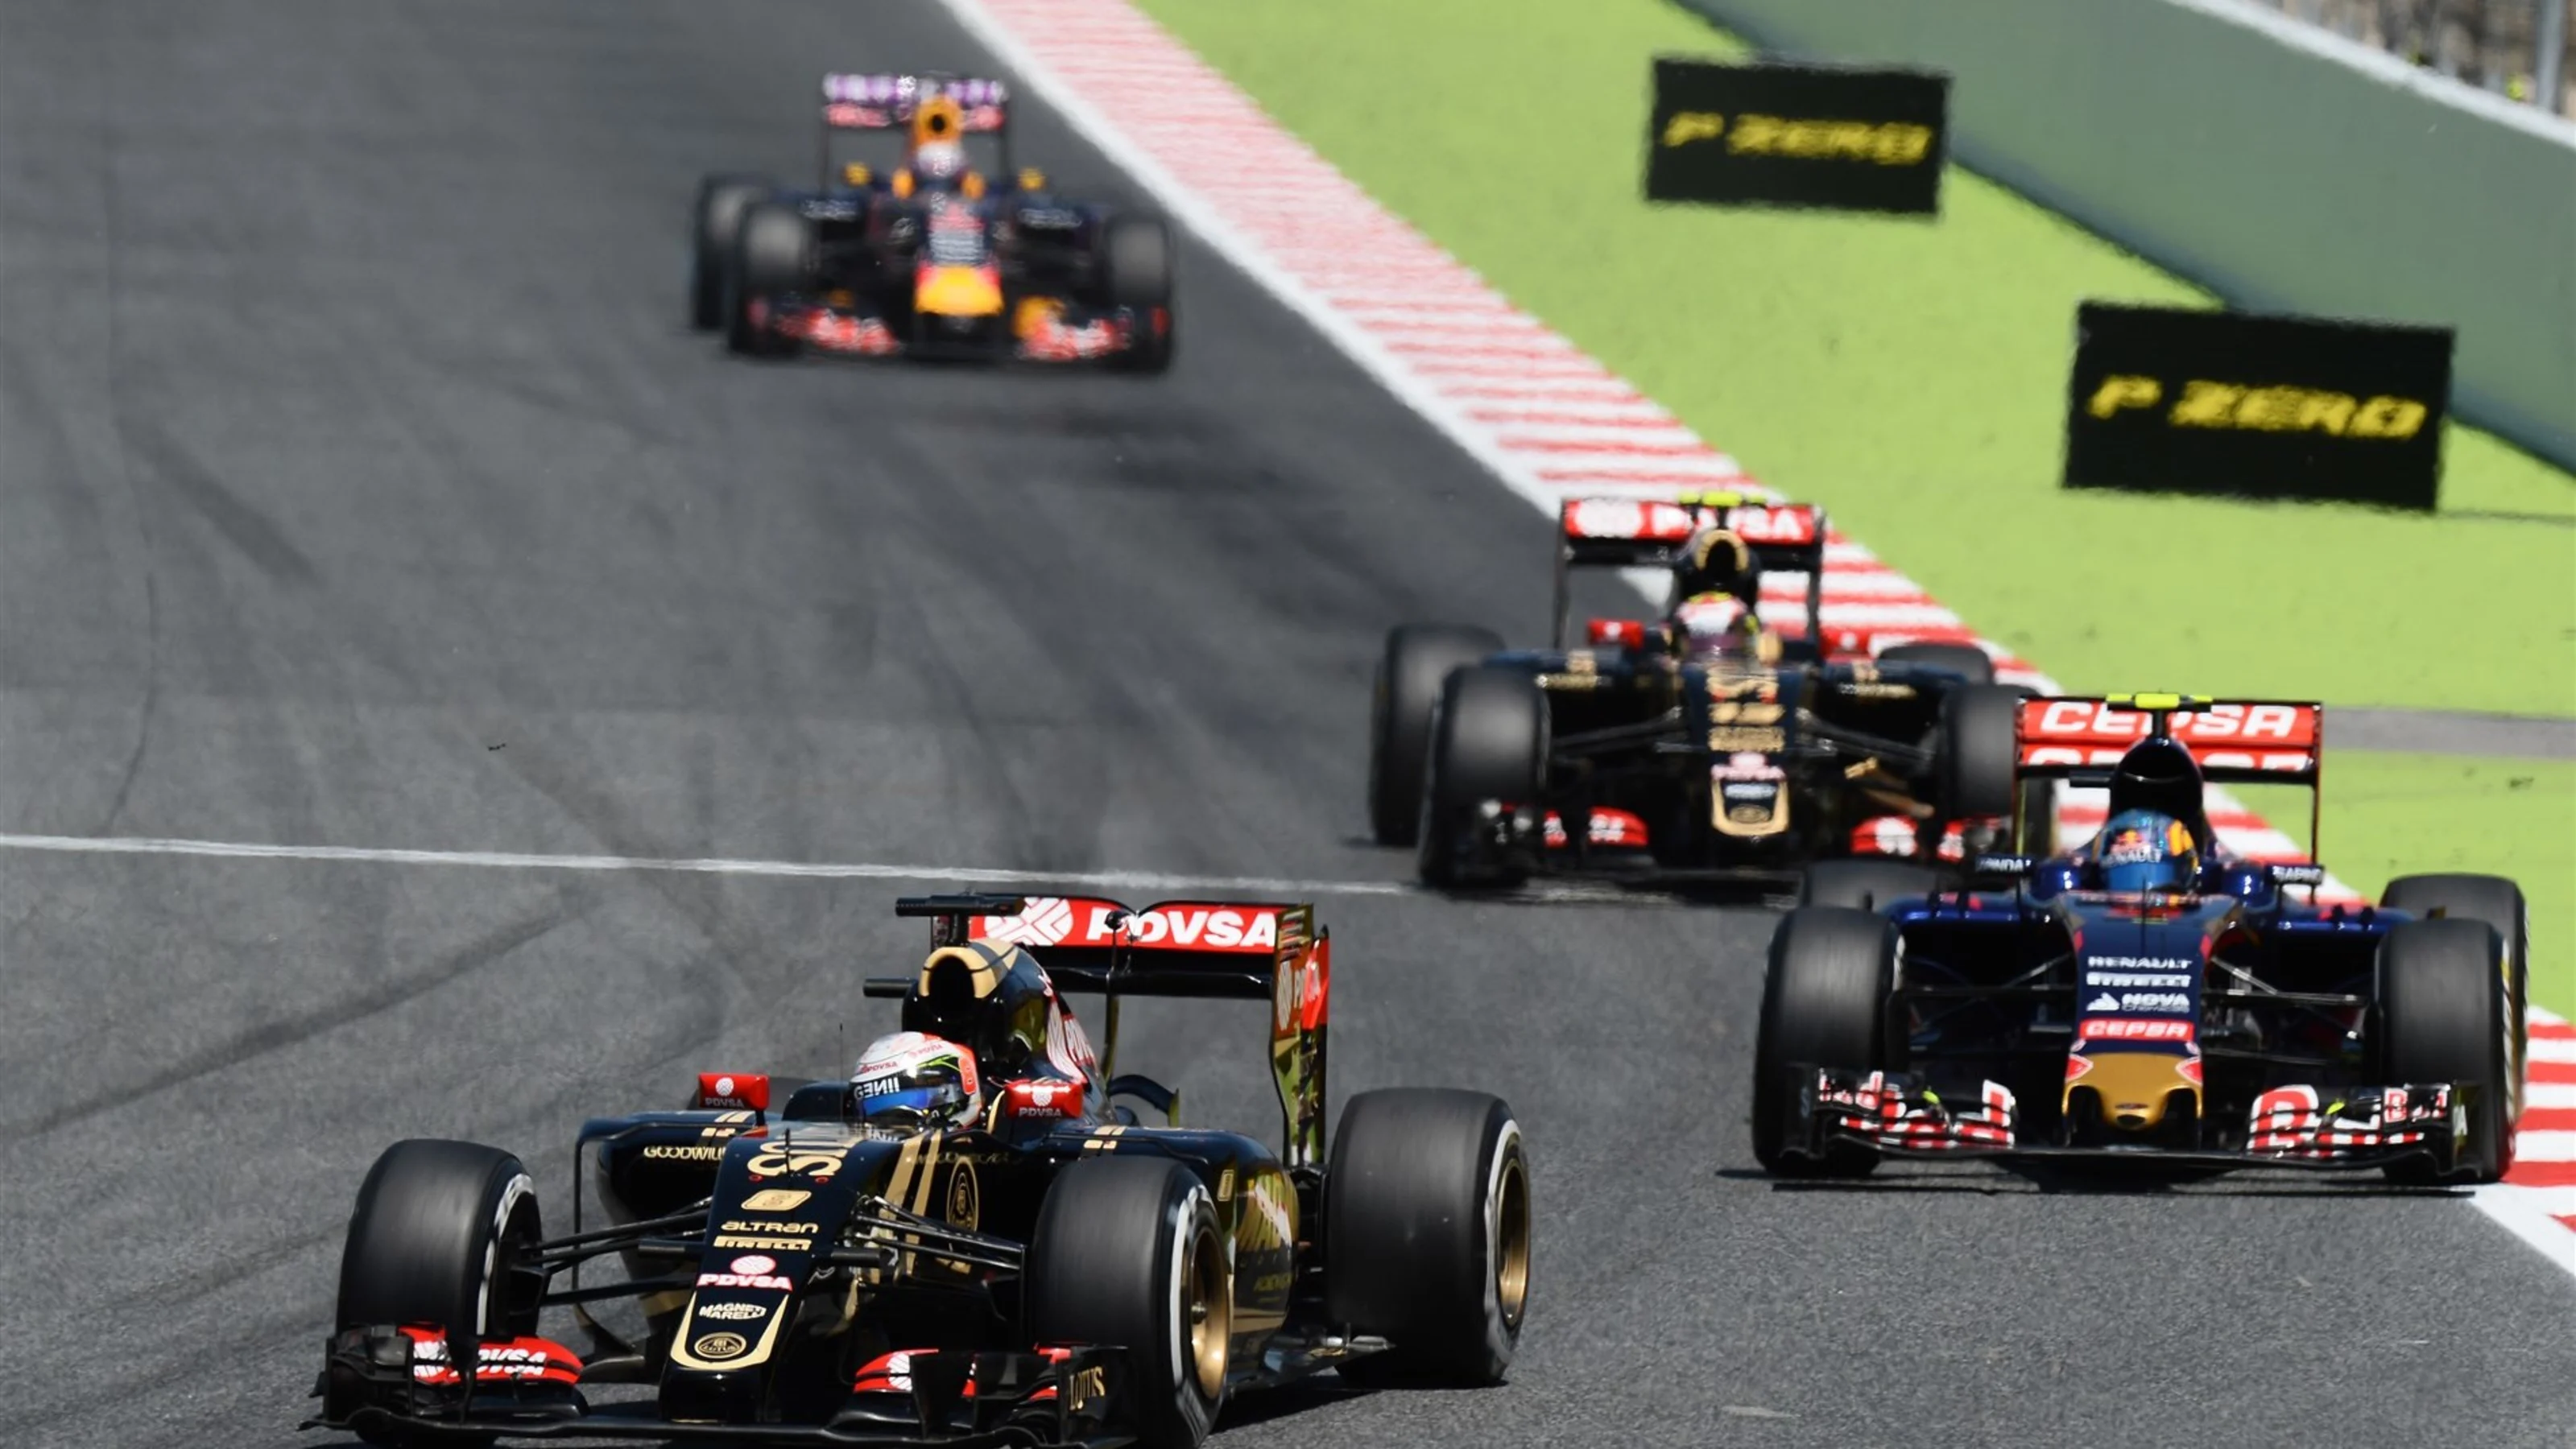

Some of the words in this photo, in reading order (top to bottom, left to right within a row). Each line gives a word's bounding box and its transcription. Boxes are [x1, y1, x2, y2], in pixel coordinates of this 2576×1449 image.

[1663, 111, 1724, 147] P
[1728, 114, 1930, 165] ZERO
[2088, 375, 2161, 418] P
[2169, 379, 2426, 440] ZERO
[2041, 702, 2297, 737] CEPSA
[1086, 906, 1276, 947] PDVSA
[2088, 956, 2194, 969] RENAULT
[2086, 972, 2192, 988] PIRELLI
[2121, 993, 2190, 1006] NOVA
[2086, 1020, 2189, 1038] CEPSA
[705, 1097, 744, 1108] PDVSA
[1018, 1107, 1062, 1118] PDVSA
[713, 1236, 812, 1251] PIRELLI
[696, 1274, 793, 1291] PDVSA
